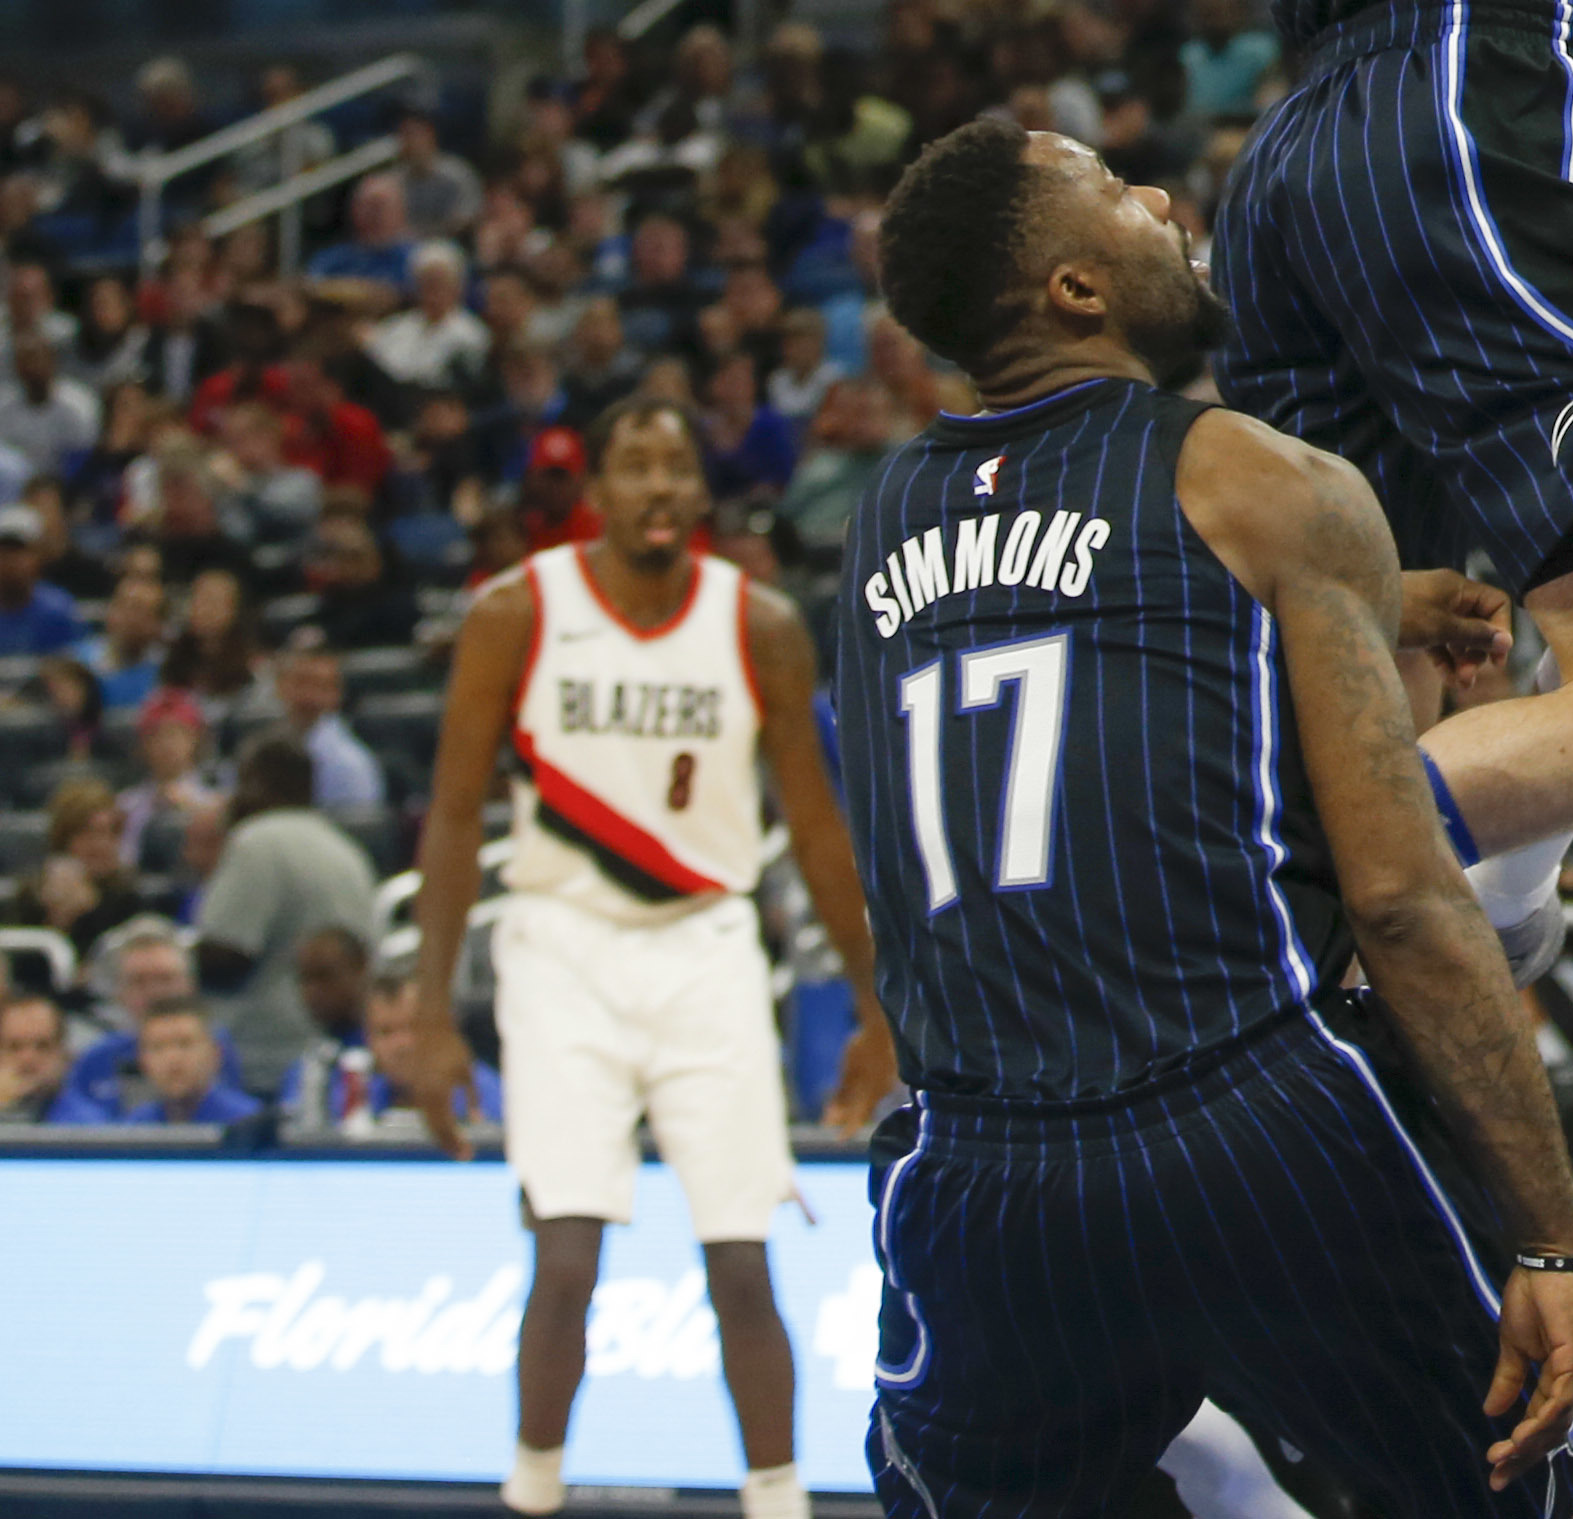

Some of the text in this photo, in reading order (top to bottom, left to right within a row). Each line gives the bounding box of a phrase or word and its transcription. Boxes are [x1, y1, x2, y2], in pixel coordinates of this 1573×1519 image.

[865, 510, 1111, 639] SIMMONS
[558, 679, 722, 739] BLAZERS
[666, 752, 697, 812] 8
[898, 627, 1073, 917] 17
